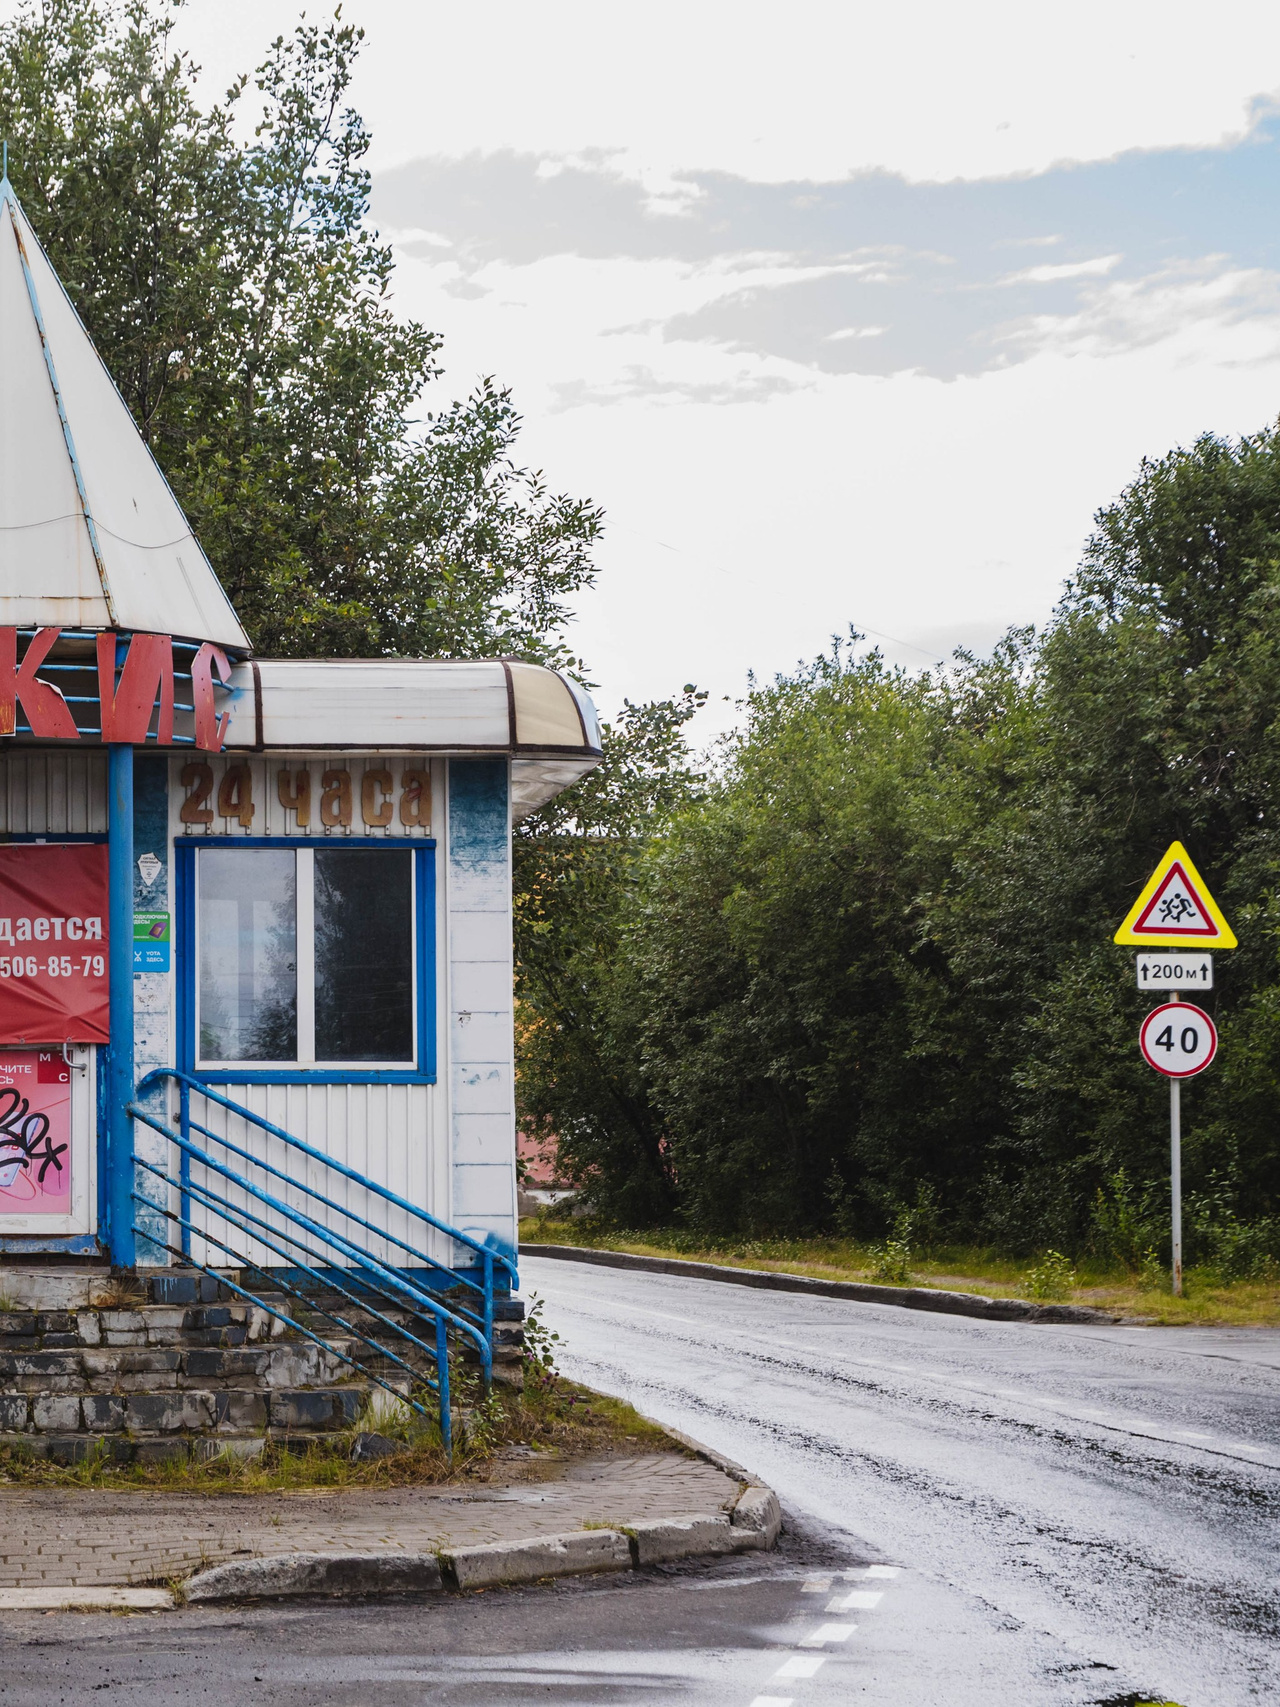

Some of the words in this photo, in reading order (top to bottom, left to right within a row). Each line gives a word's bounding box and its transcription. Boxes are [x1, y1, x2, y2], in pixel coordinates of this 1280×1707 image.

[180, 762, 255, 827] 24
[278, 768, 432, 827] часа
[1152, 964, 1183, 979] 200
[1155, 1025, 1199, 1053] 40
